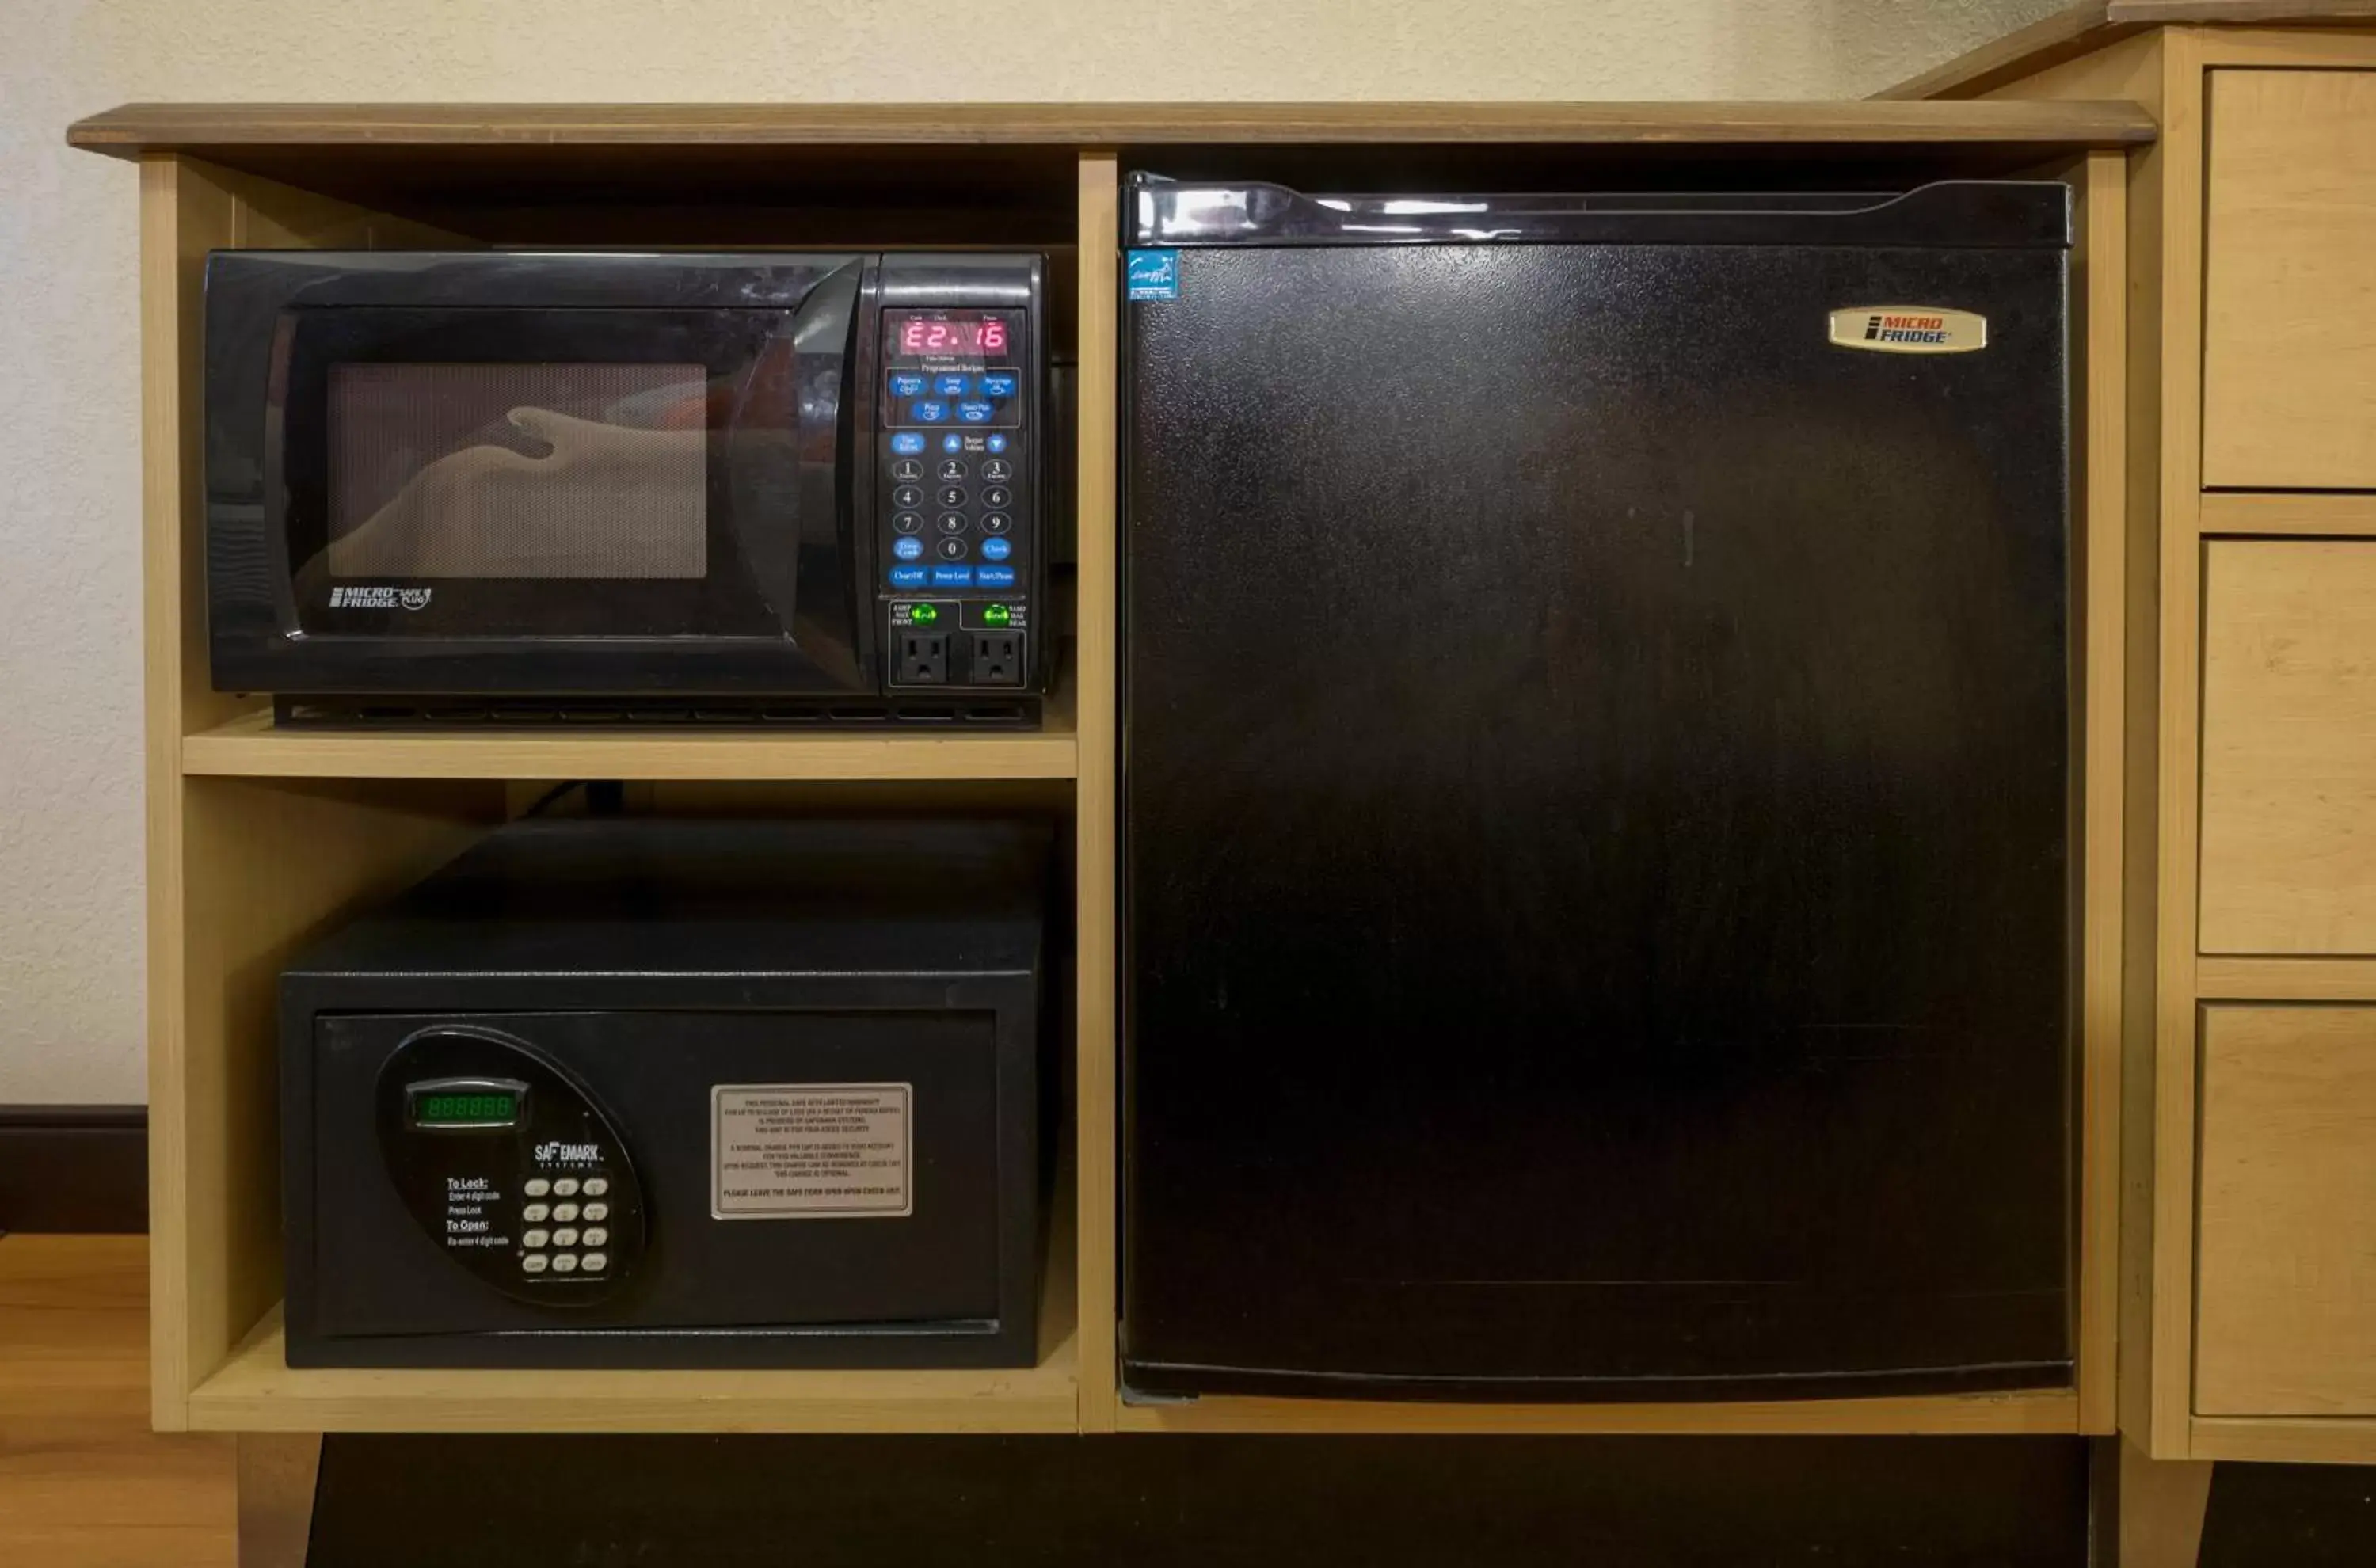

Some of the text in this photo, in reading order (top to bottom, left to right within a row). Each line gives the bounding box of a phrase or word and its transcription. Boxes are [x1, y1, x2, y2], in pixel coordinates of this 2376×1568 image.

[1883, 316, 1943, 330] MICRO
[1879, 329, 1947, 343] FRIDGE
[904, 462, 911, 474] 1
[947, 462, 957, 474] 2
[992, 462, 1001, 474] 3
[902, 490, 912, 503] 4
[947, 491, 957, 503] 5
[992, 491, 1001, 503] 6
[903, 516, 912, 529] 7
[947, 516, 957, 529] 8
[992, 516, 1001, 528] 9
[947, 543, 957, 556] 0
[344, 586, 394, 597] MICRO
[341, 596, 398, 608] FRIDGE
[535, 1141, 599, 1162] SAFEMARK
[447, 1178, 489, 1189] To Lock:
[466, 1205, 482, 1215] Lock
[446, 1219, 489, 1232] To Open:
